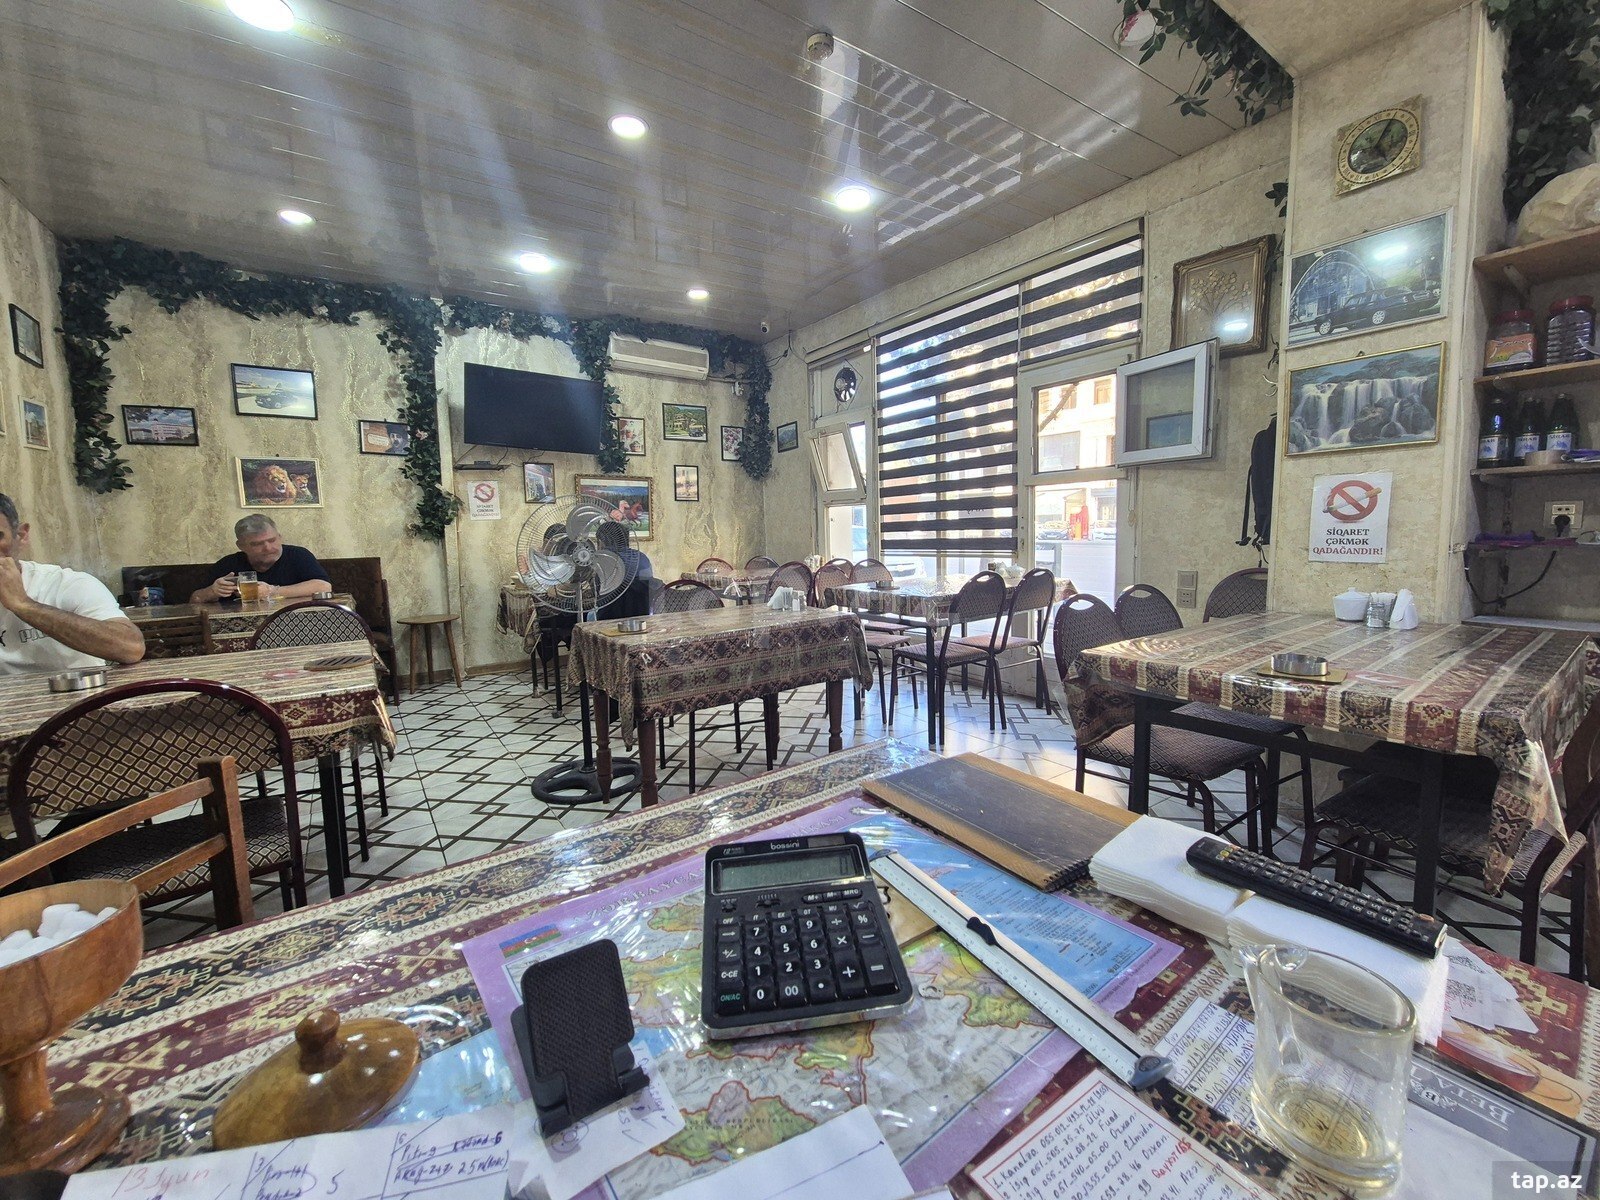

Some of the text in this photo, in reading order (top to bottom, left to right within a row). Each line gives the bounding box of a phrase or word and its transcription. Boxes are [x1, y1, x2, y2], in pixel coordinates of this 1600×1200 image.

[1326, 527, 1370, 537] SİQARET
[1325, 538, 1369, 546] ÇƏKMƏK
[1313, 546, 1383, 555] QADAĞANDIR!
[770, 840, 800, 850] bossini
[753, 927, 760, 936] 7
[780, 925, 787, 934] 8
[806, 921, 813, 929] 9
[754, 947, 761, 956] 4
[783, 944, 790, 952] 5
[810, 939, 818, 948] 6
[755, 966, 761, 976] 1
[785, 963, 793, 972] 2
[814, 960, 821, 969] 3
